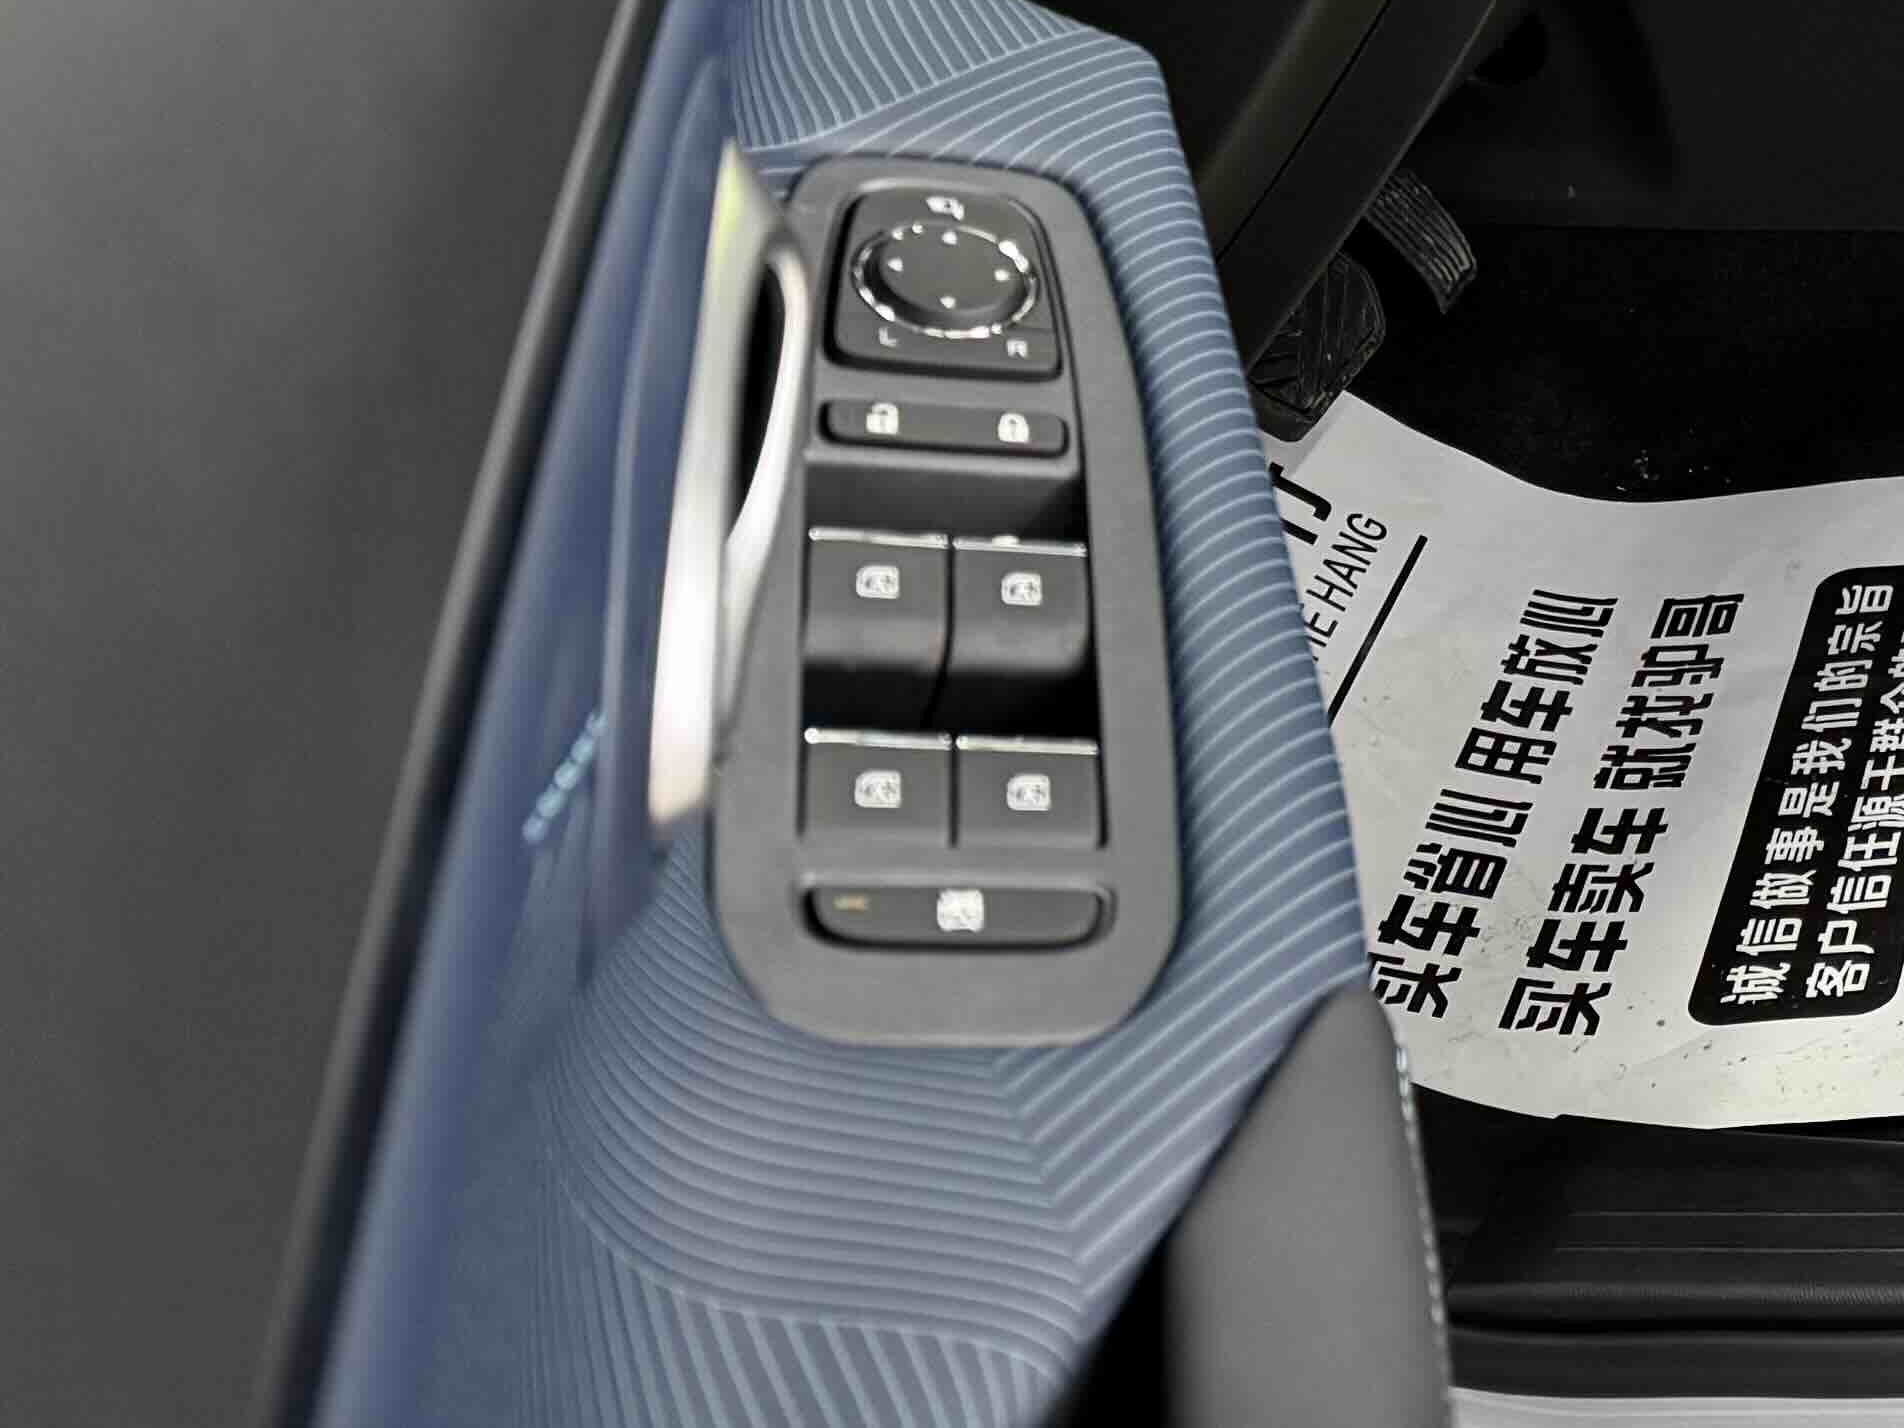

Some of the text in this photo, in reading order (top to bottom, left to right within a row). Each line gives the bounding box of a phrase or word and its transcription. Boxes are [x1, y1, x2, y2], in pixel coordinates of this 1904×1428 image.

[1305, 512, 1388, 612] HANG
[1368, 588, 1618, 1019] 买车省心 用车放心
[1497, 592, 1744, 1037] 买车卖车 就找驴哥
[1720, 584, 1894, 1006] 诚信做事是我们的宗旨
